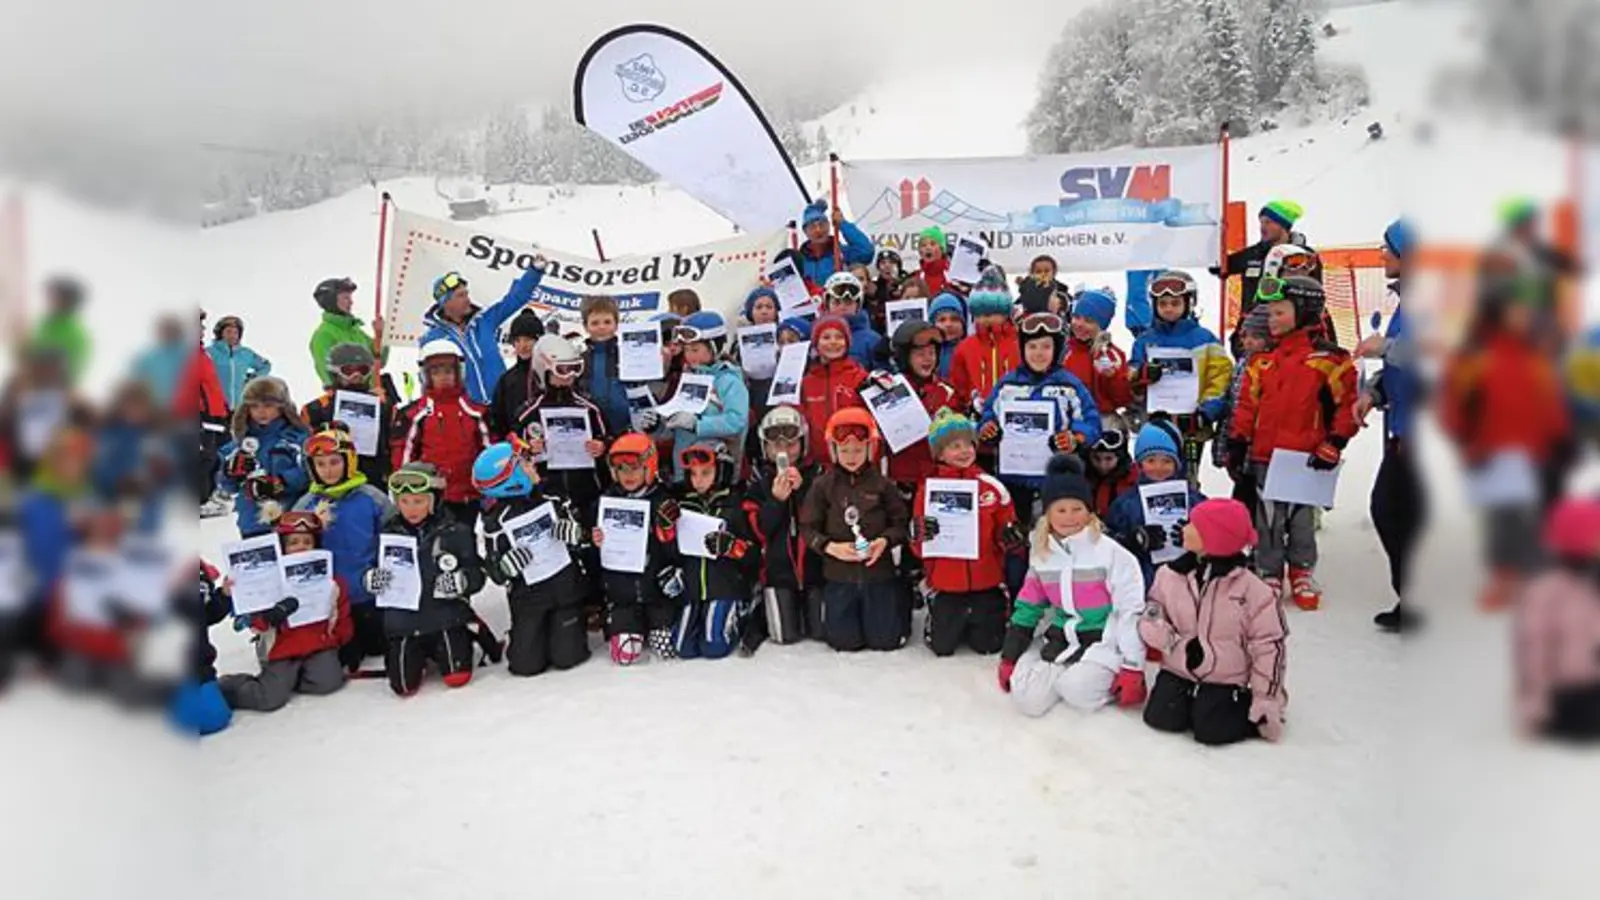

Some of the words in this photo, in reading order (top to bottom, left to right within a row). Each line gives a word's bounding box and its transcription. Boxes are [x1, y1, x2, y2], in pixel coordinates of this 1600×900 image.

[1059, 165, 1171, 206] SVM
[465, 235, 662, 287] Sponsored
[672, 252, 714, 282] by
